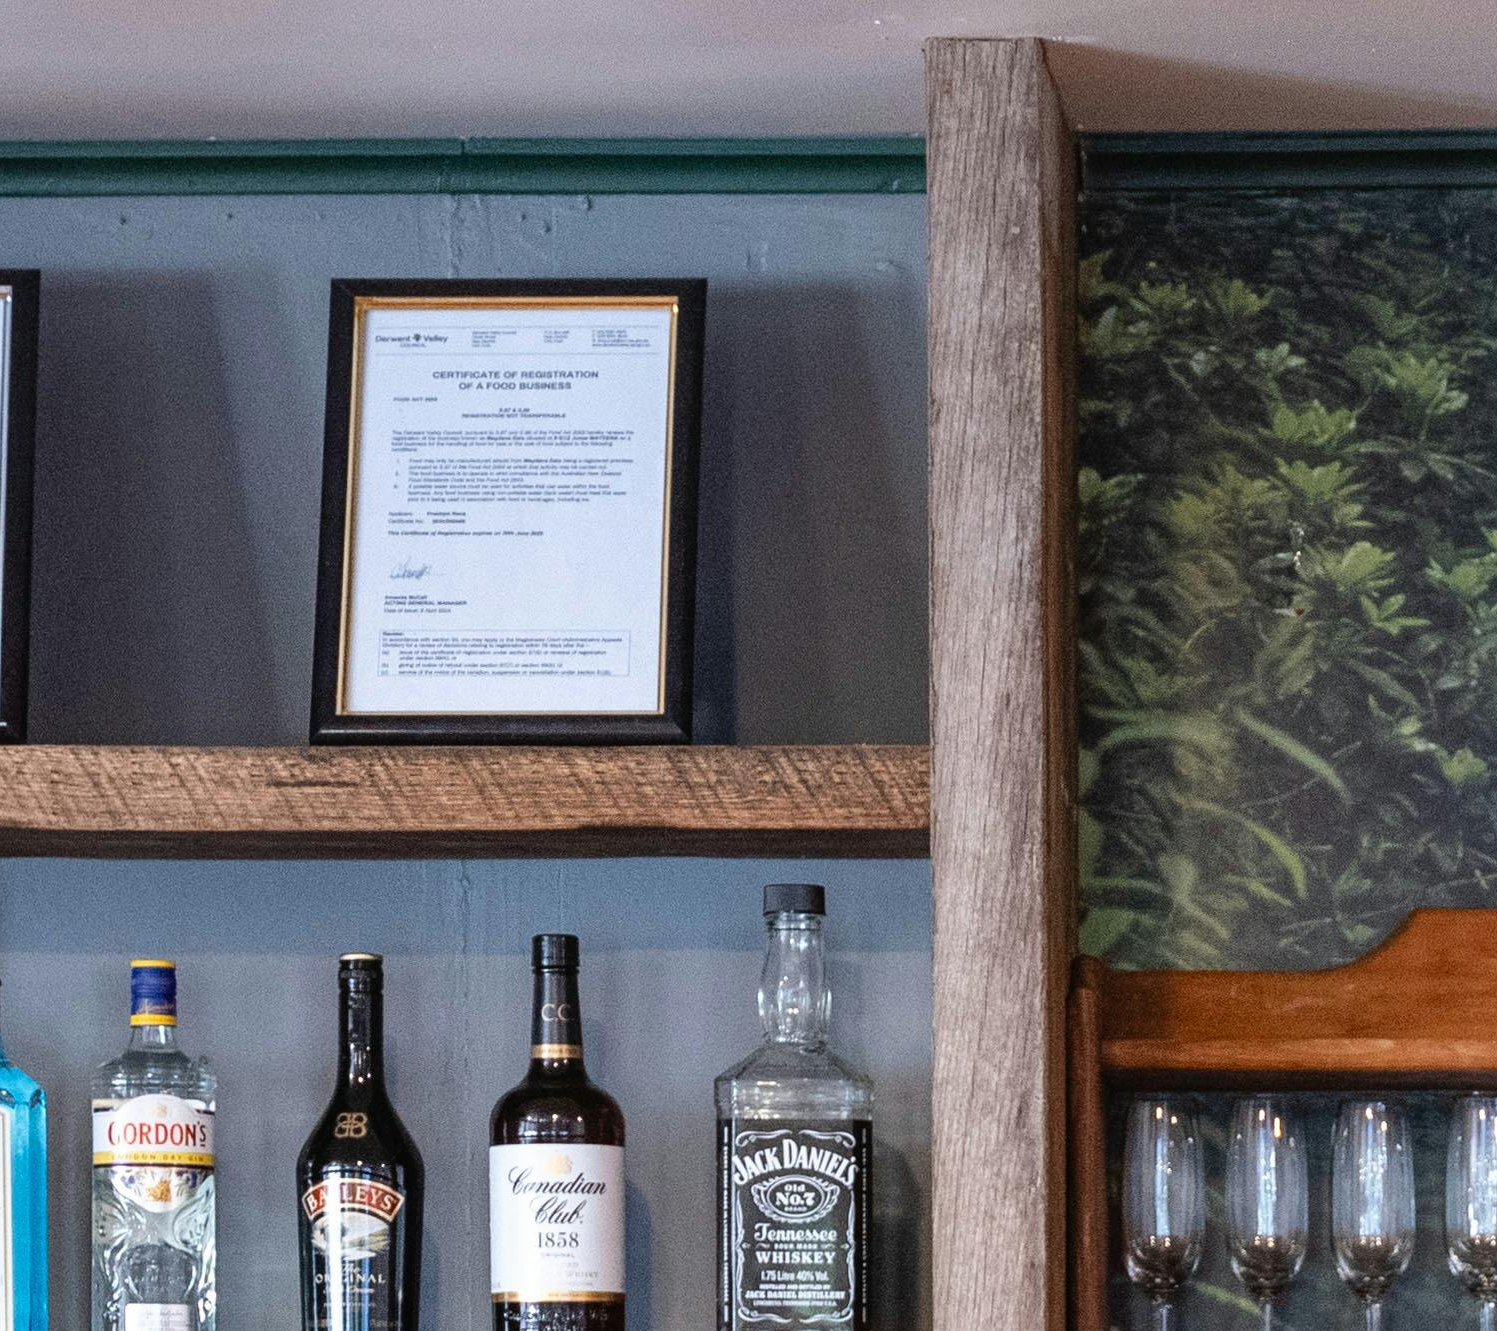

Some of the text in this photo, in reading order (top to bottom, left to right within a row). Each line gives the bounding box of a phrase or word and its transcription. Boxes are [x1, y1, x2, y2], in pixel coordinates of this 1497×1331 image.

[423, 334, 448, 344] Valley
[432, 370, 599, 380] CERTIFICATE OF REGISTRATION
[458, 382, 474, 391] OF
[485, 382, 517, 391] FOOD
[518, 382, 572, 391] BUSINESS
[733, 1139, 860, 1188] JACK DANIEL'S
[508, 1166, 608, 1195] Canadian
[784, 1184, 806, 1192] Old
[306, 1183, 394, 1212] BALEYS
[753, 1222, 838, 1242] Tennessee
[537, 1231, 580, 1249] 1858
[755, 1251, 836, 1264] WHISKEY
[745, 1290, 846, 1299] JACK DANIEL DISTILLERY
